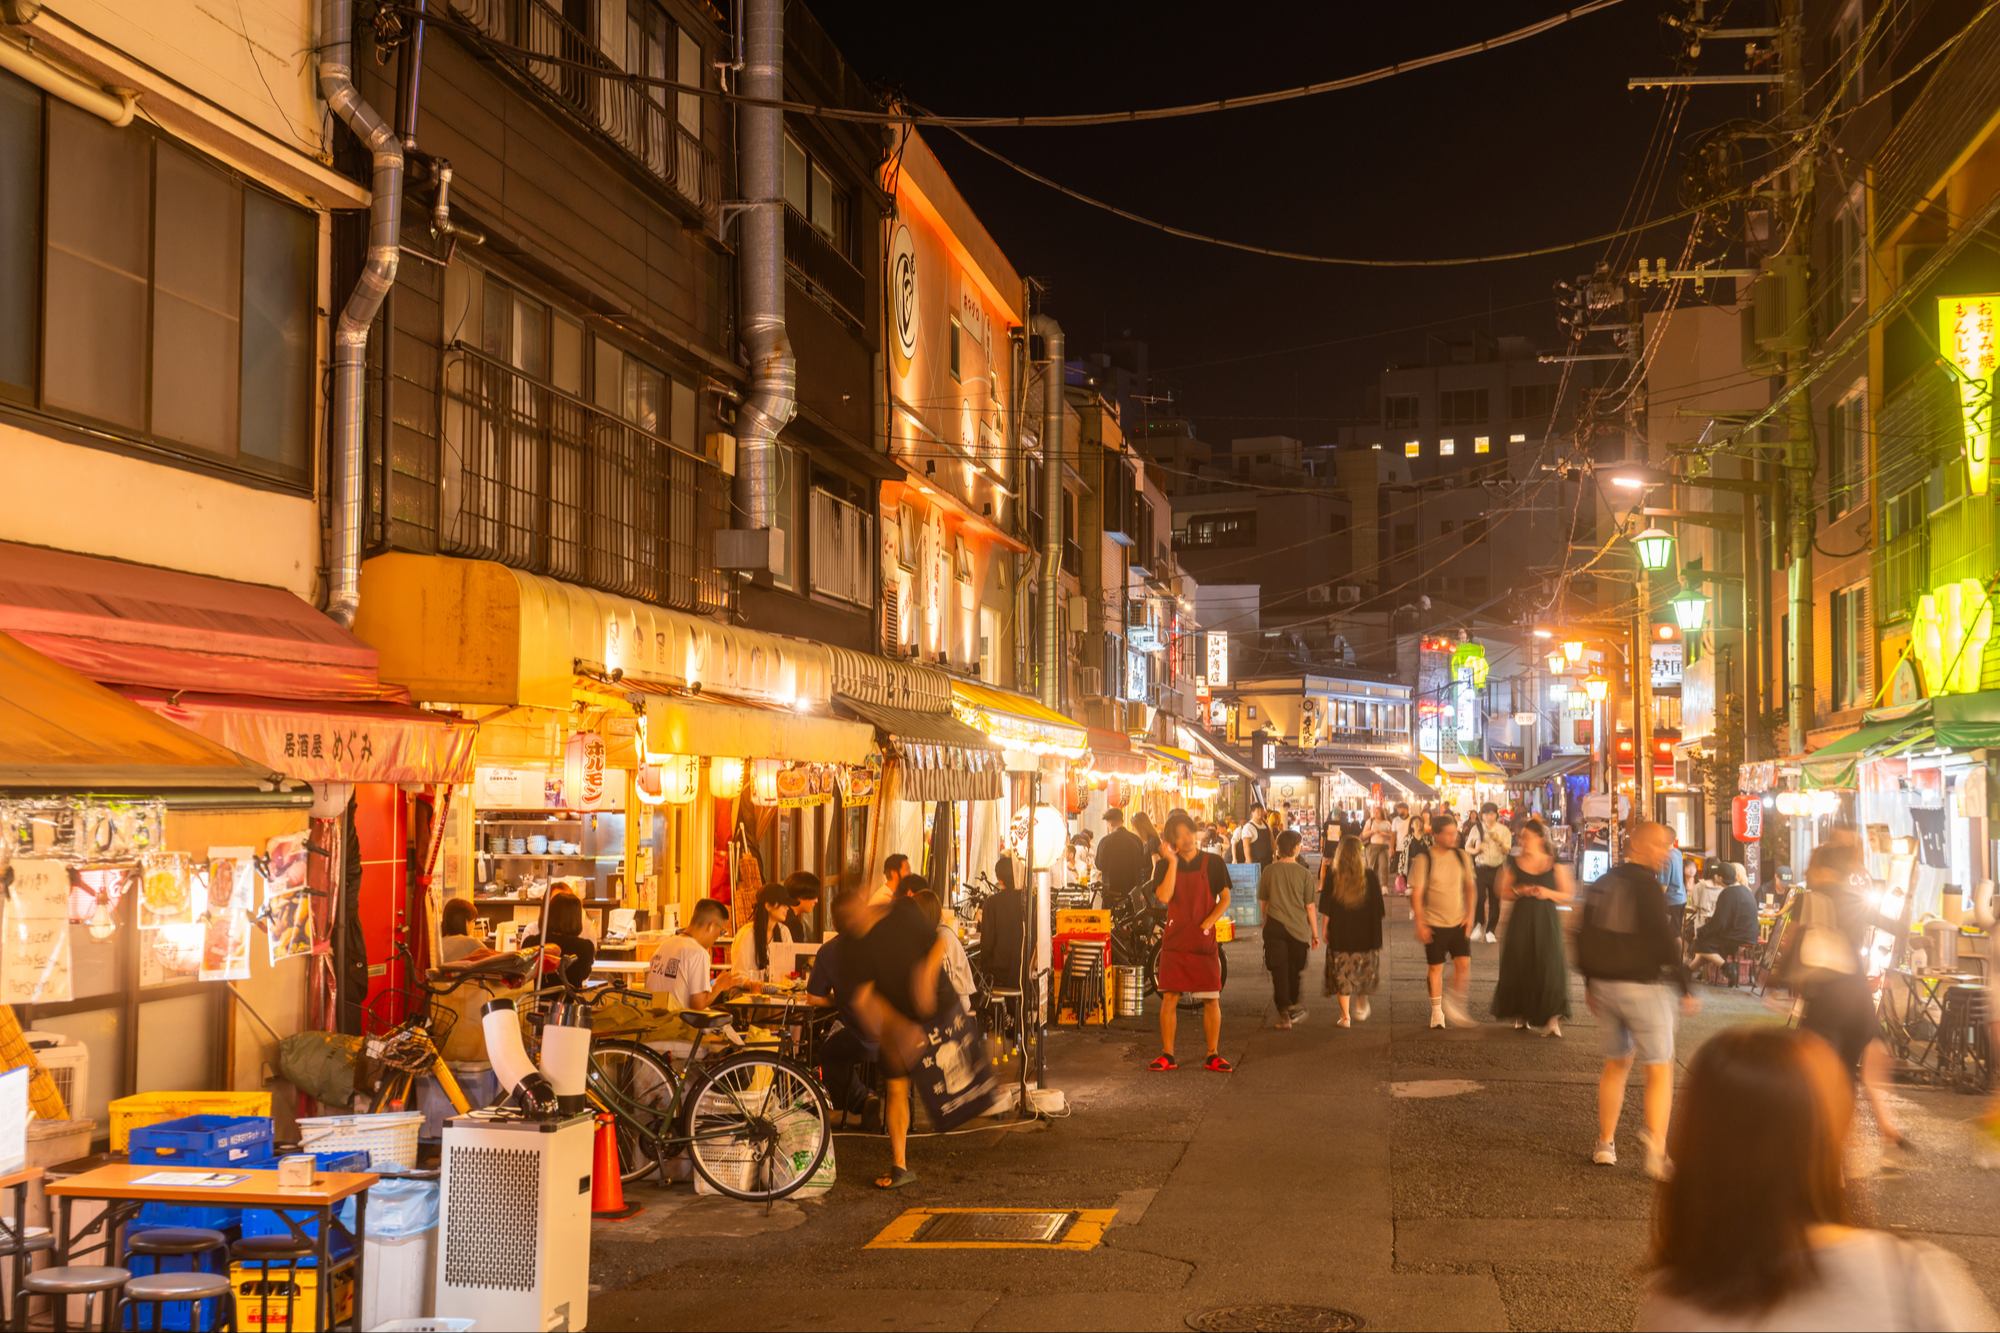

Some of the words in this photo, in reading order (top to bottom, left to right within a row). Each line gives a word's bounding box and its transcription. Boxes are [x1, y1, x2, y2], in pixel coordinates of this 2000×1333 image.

[1954, 303, 1971, 368] もんじゃ
[1978, 302, 1996, 369] お好み焼
[285, 733, 324, 760] 居酒屋
[333, 730, 373, 763] めぐみ
[582, 741, 604, 804] ホルモン
[684, 754, 698, 796] ボール
[1744, 800, 1760, 837] 居酒屋
